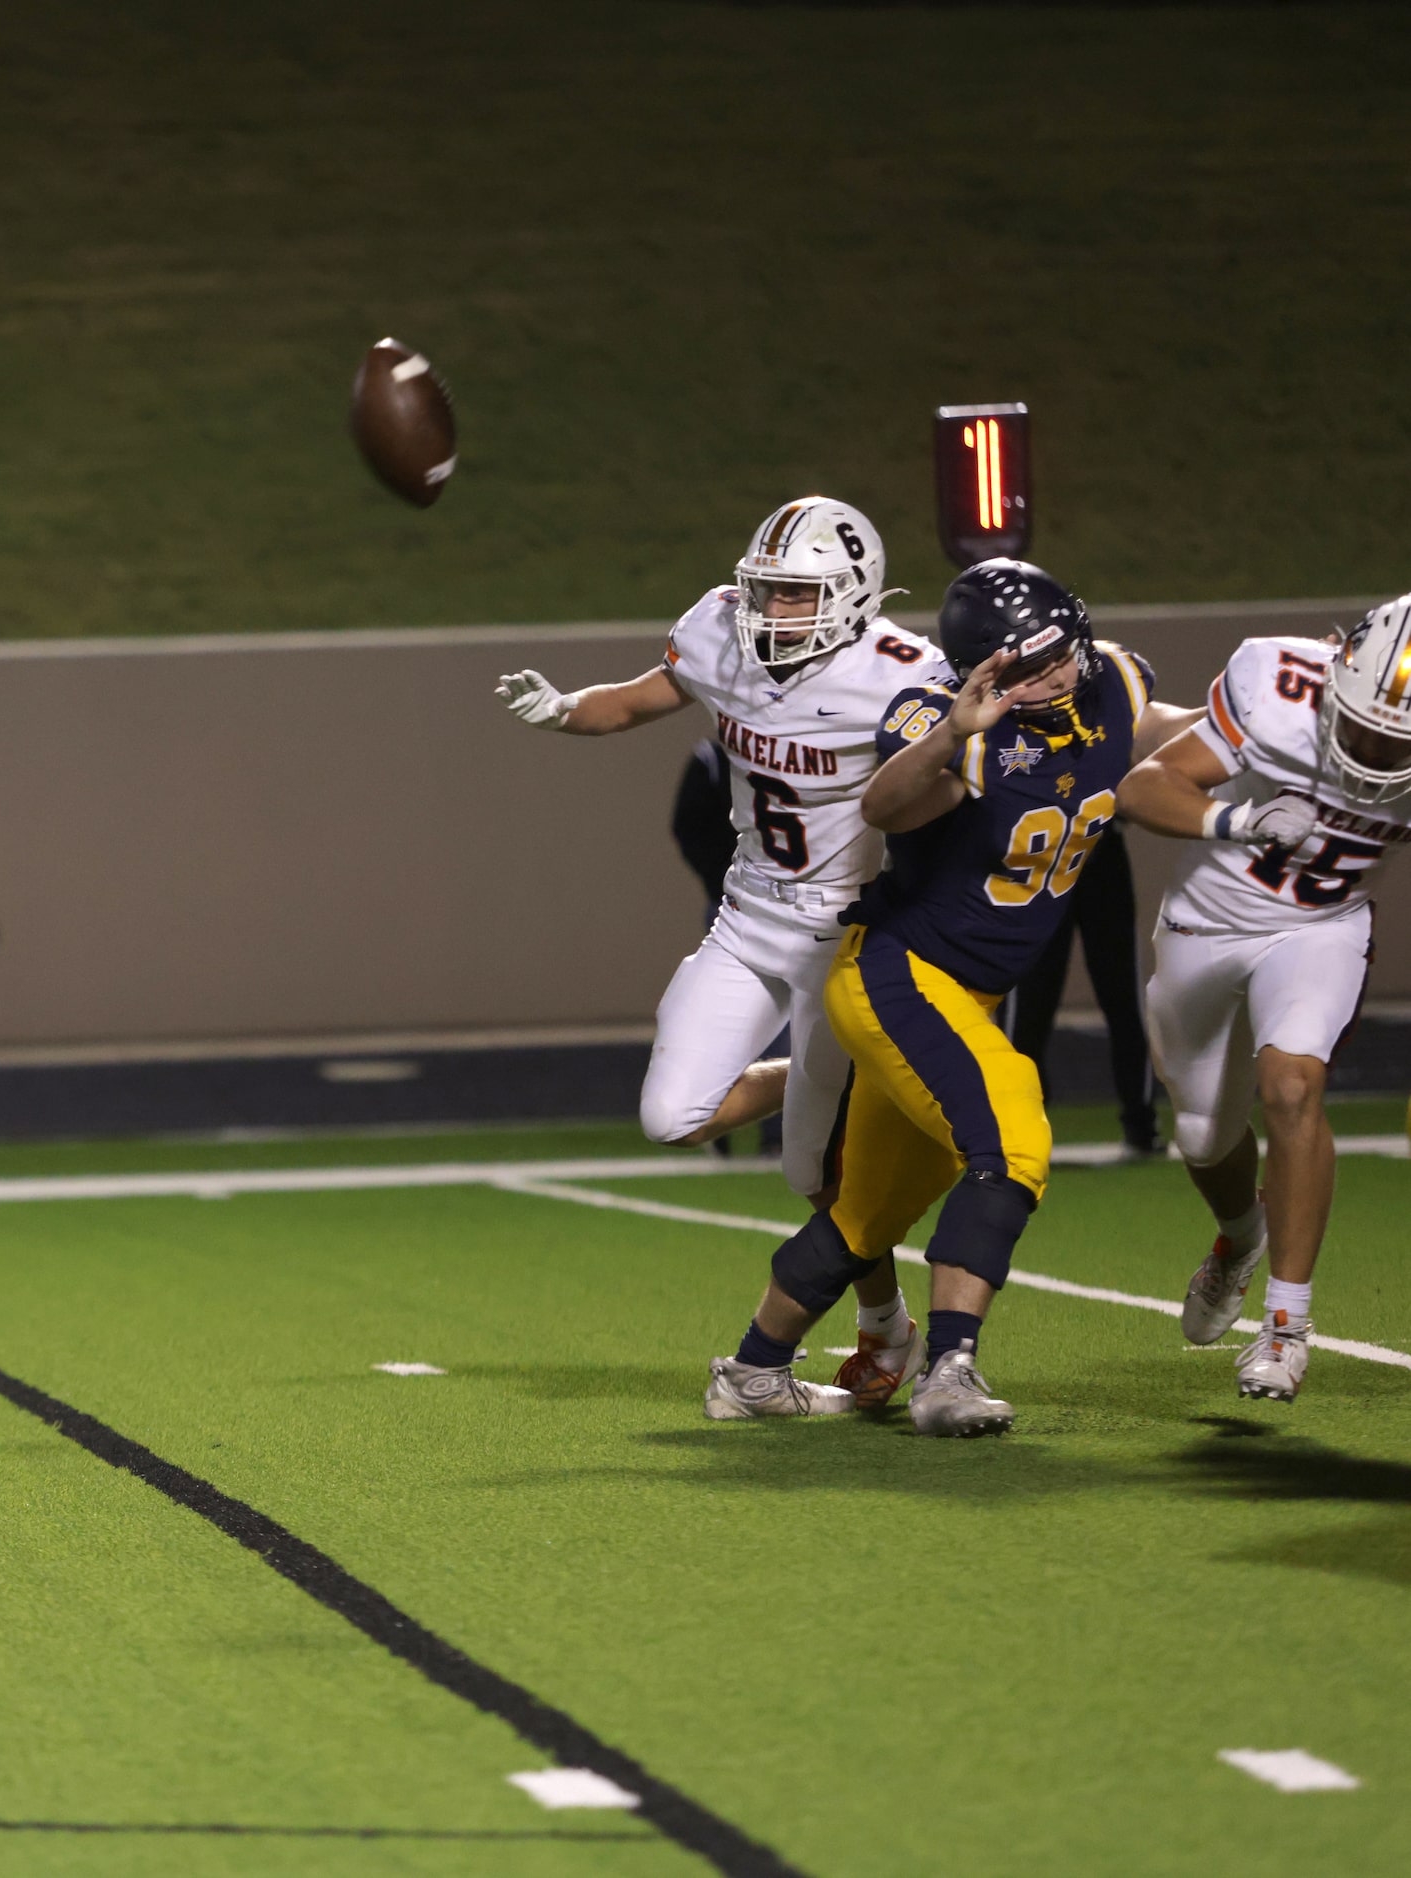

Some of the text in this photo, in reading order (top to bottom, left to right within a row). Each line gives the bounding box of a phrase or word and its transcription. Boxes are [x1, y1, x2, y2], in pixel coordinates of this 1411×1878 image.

[963, 418, 1003, 529] 1
[835, 522, 865, 561] 6
[875, 634, 924, 665] 6
[1275, 650, 1327, 714] 15
[717, 711, 838, 776] WAKELAND
[884, 699, 942, 742] 96
[746, 771, 810, 874] 6
[983, 788, 1116, 907] 96
[1245, 833, 1387, 908] 15
